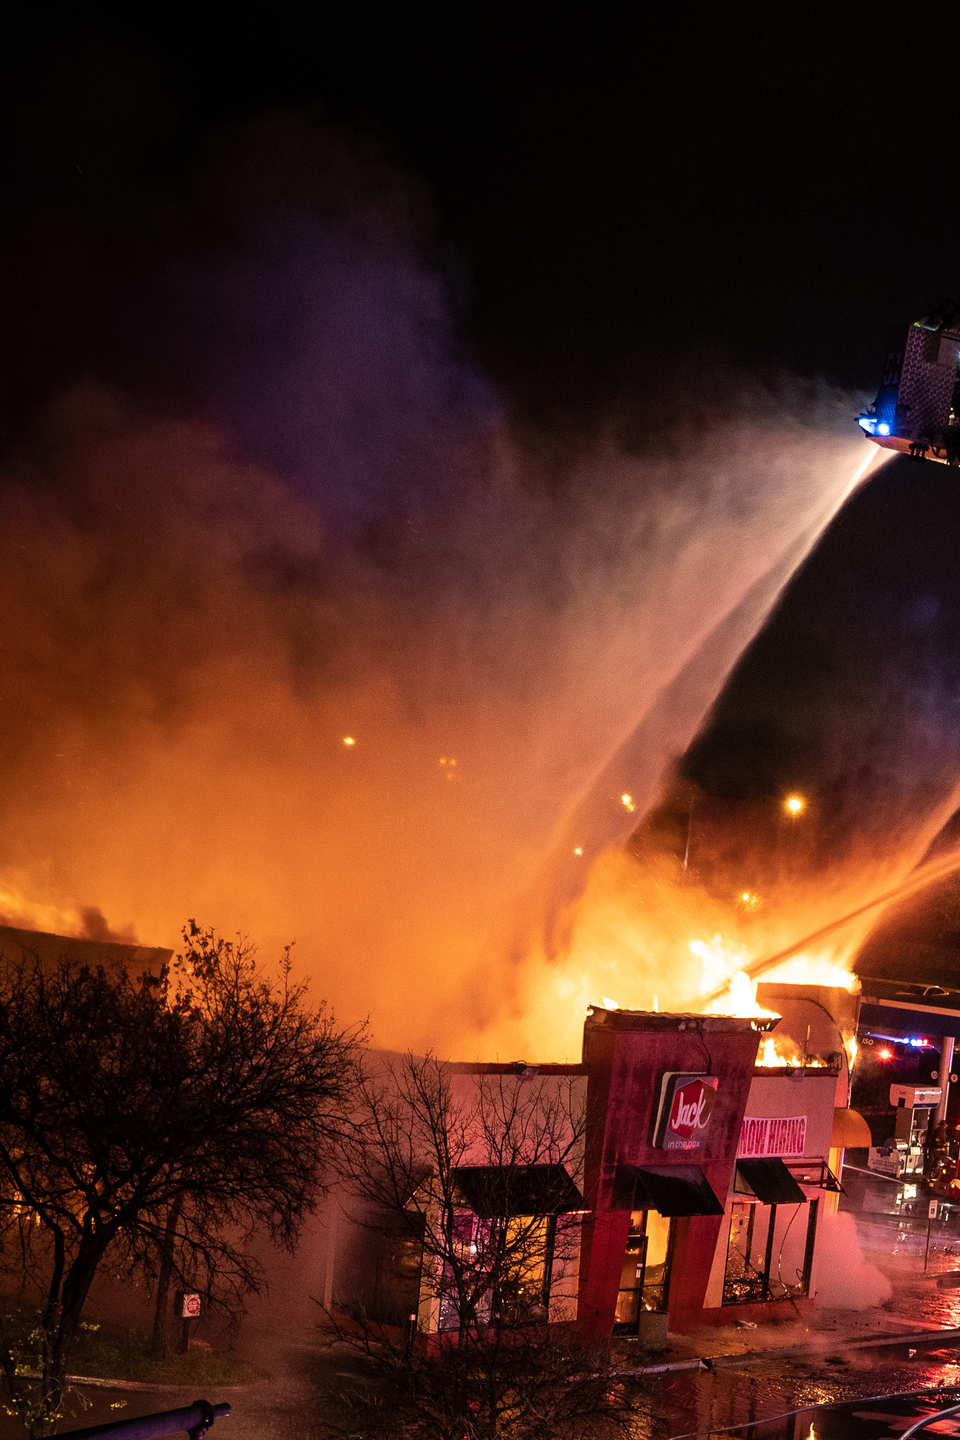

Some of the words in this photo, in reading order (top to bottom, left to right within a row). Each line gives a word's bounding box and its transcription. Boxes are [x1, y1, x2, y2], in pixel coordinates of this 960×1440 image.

[671, 1088, 711, 1130] Jack
[740, 1119, 768, 1155] NOW
[768, 1118, 806, 1154] HIRING
